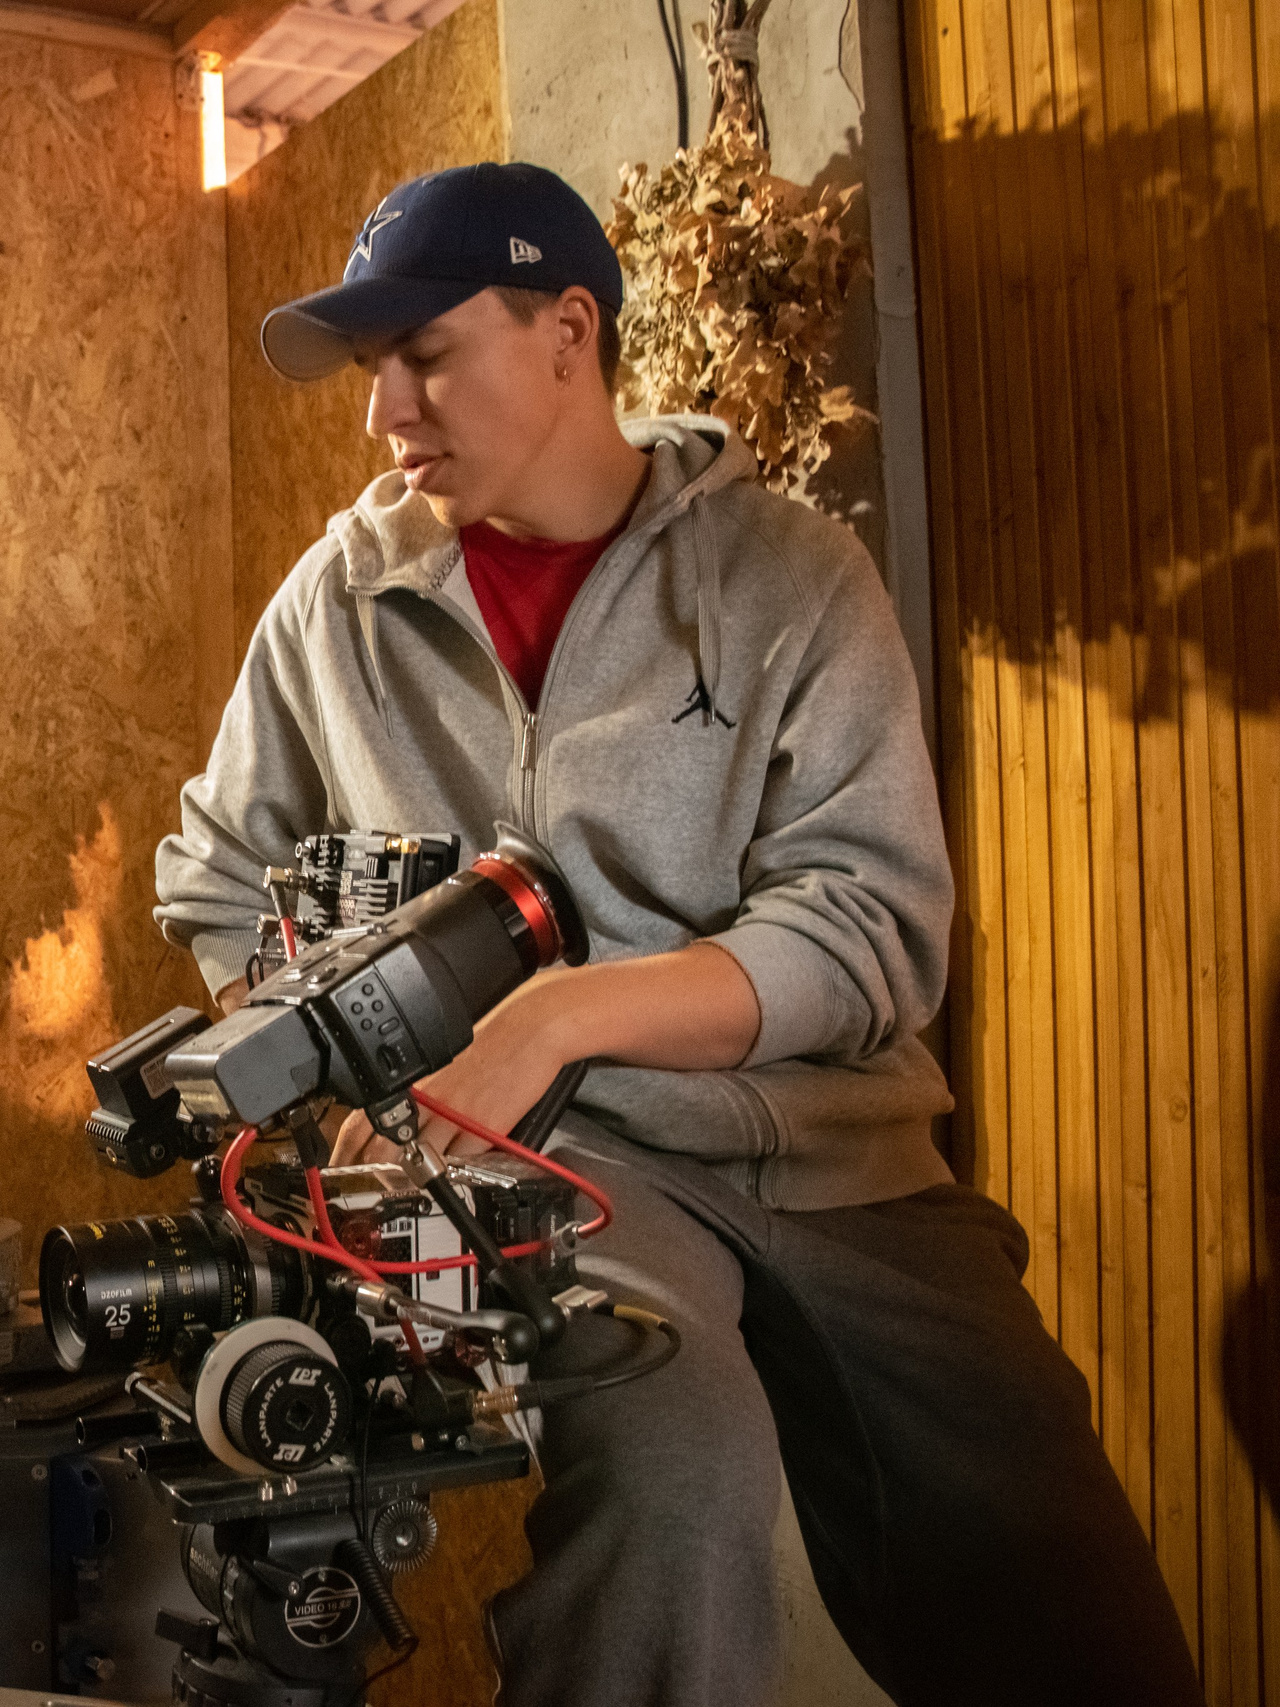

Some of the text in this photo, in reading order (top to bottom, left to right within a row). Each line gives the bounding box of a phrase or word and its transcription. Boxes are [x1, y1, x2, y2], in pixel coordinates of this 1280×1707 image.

[100, 1287, 133, 1300] DZOFILM
[104, 1303, 131, 1328] 25
[258, 1377, 285, 1448] LANPARTE
[312, 1382, 338, 1453] LANPARTE
[294, 1602, 325, 1616] VIDEO
